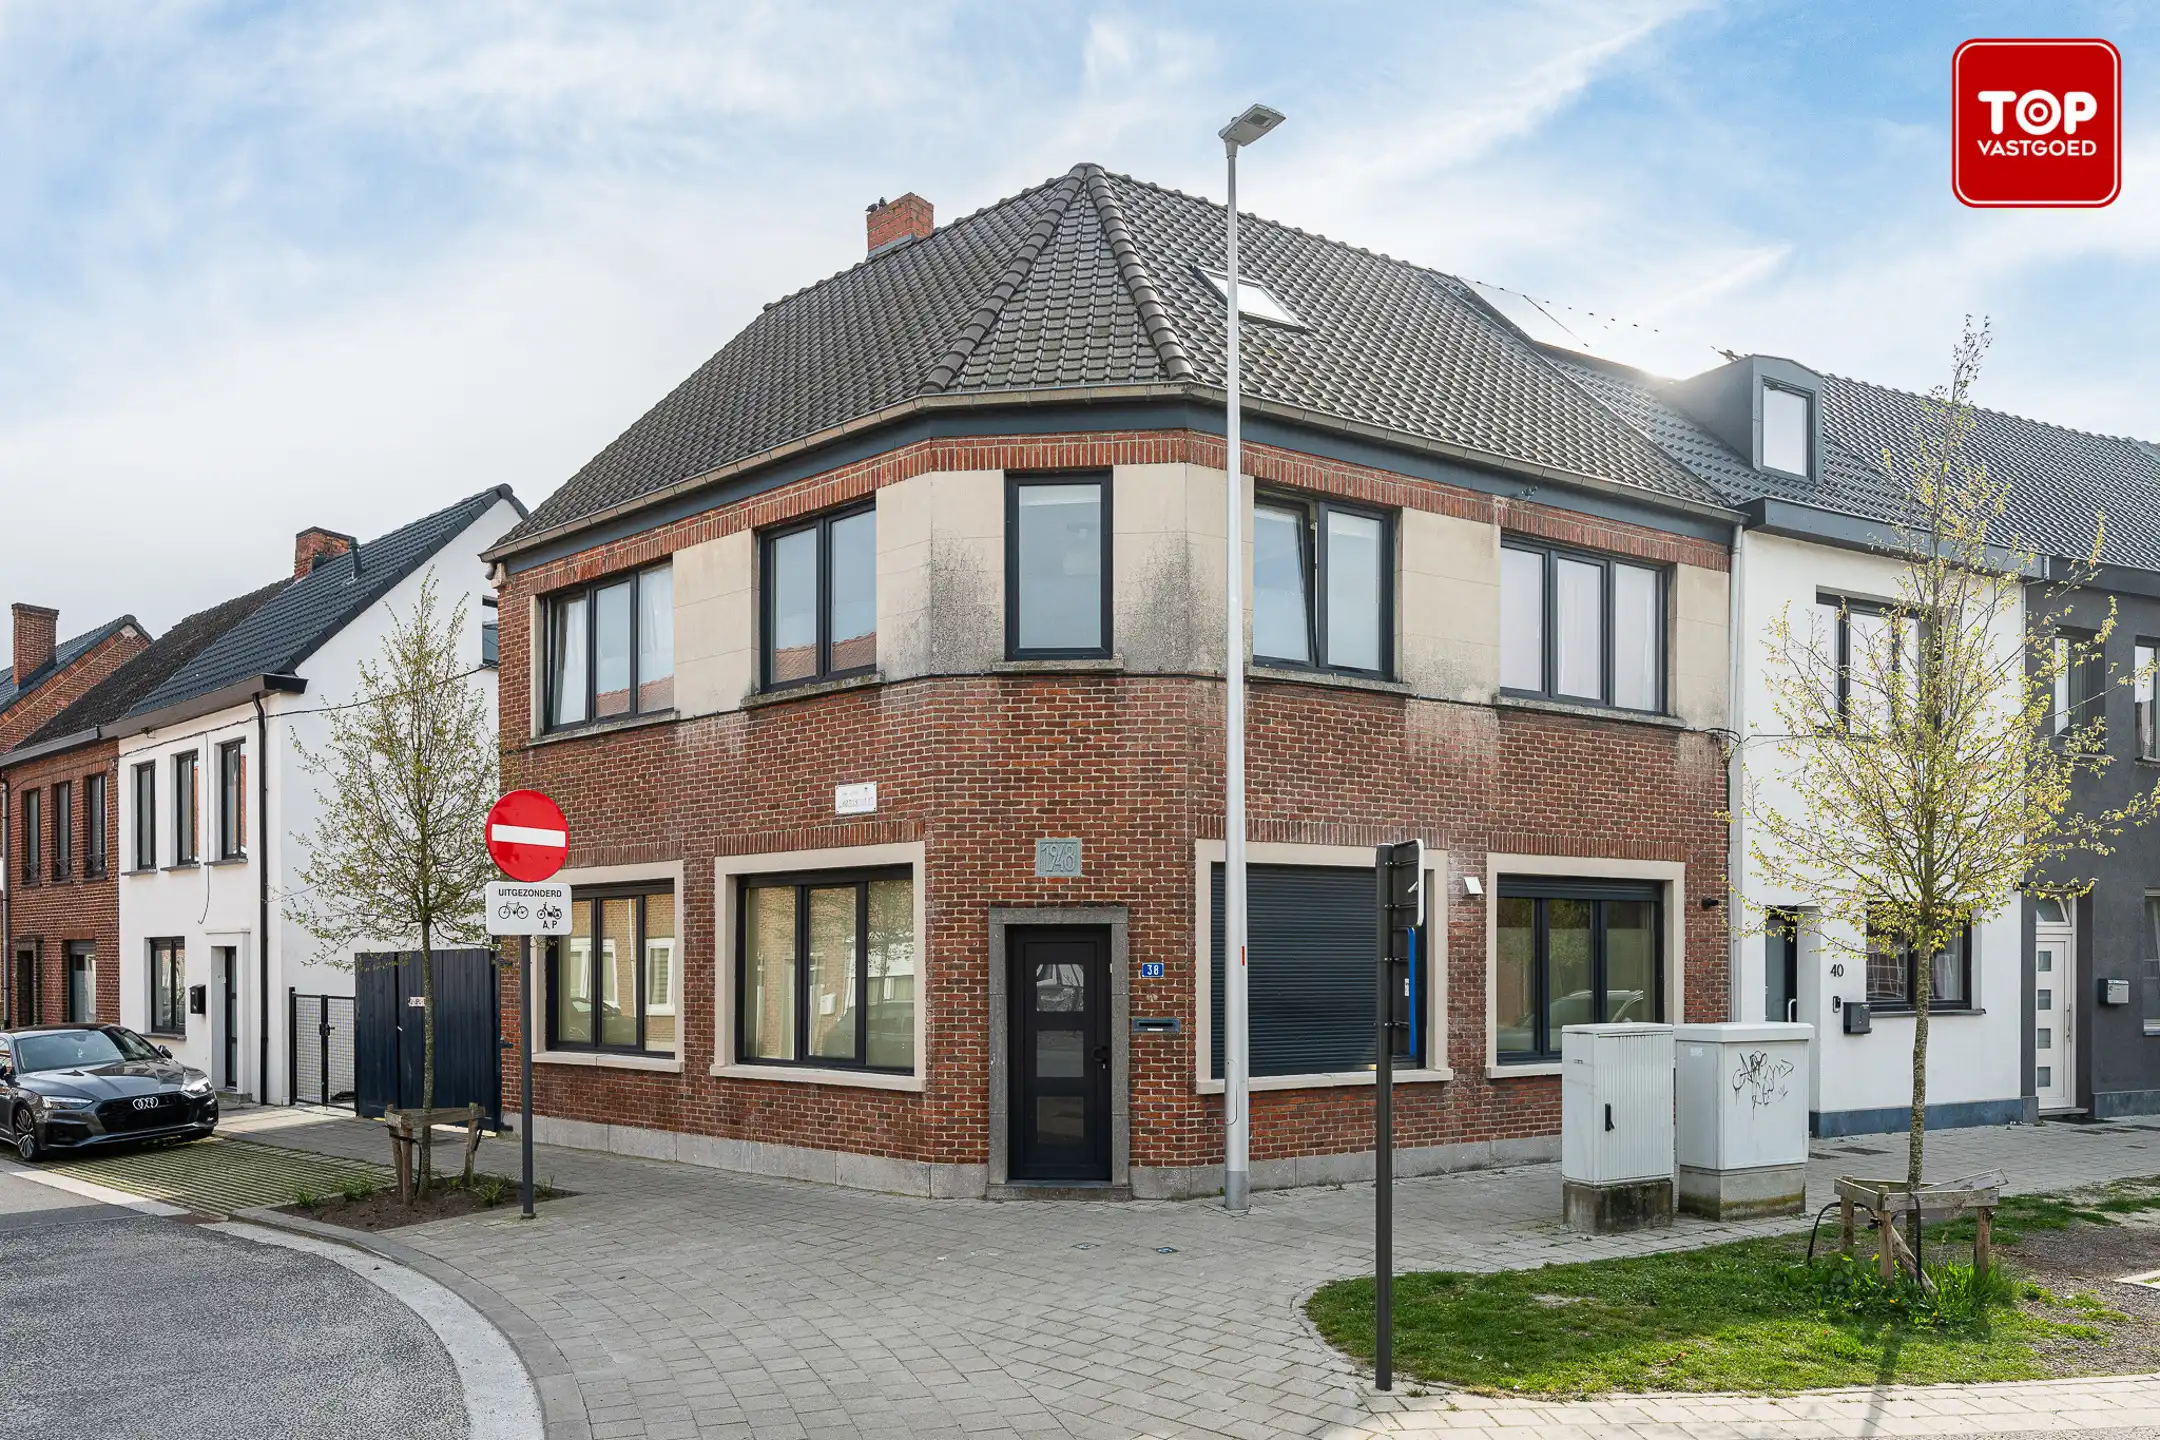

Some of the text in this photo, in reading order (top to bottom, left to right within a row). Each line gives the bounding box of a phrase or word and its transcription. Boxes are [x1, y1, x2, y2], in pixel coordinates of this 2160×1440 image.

[1040, 842, 1076, 873] 1948
[498, 888, 562, 898] UITGEZONDERD
[1146, 964, 1159, 976] 38
[1830, 963, 1844, 978] 40
